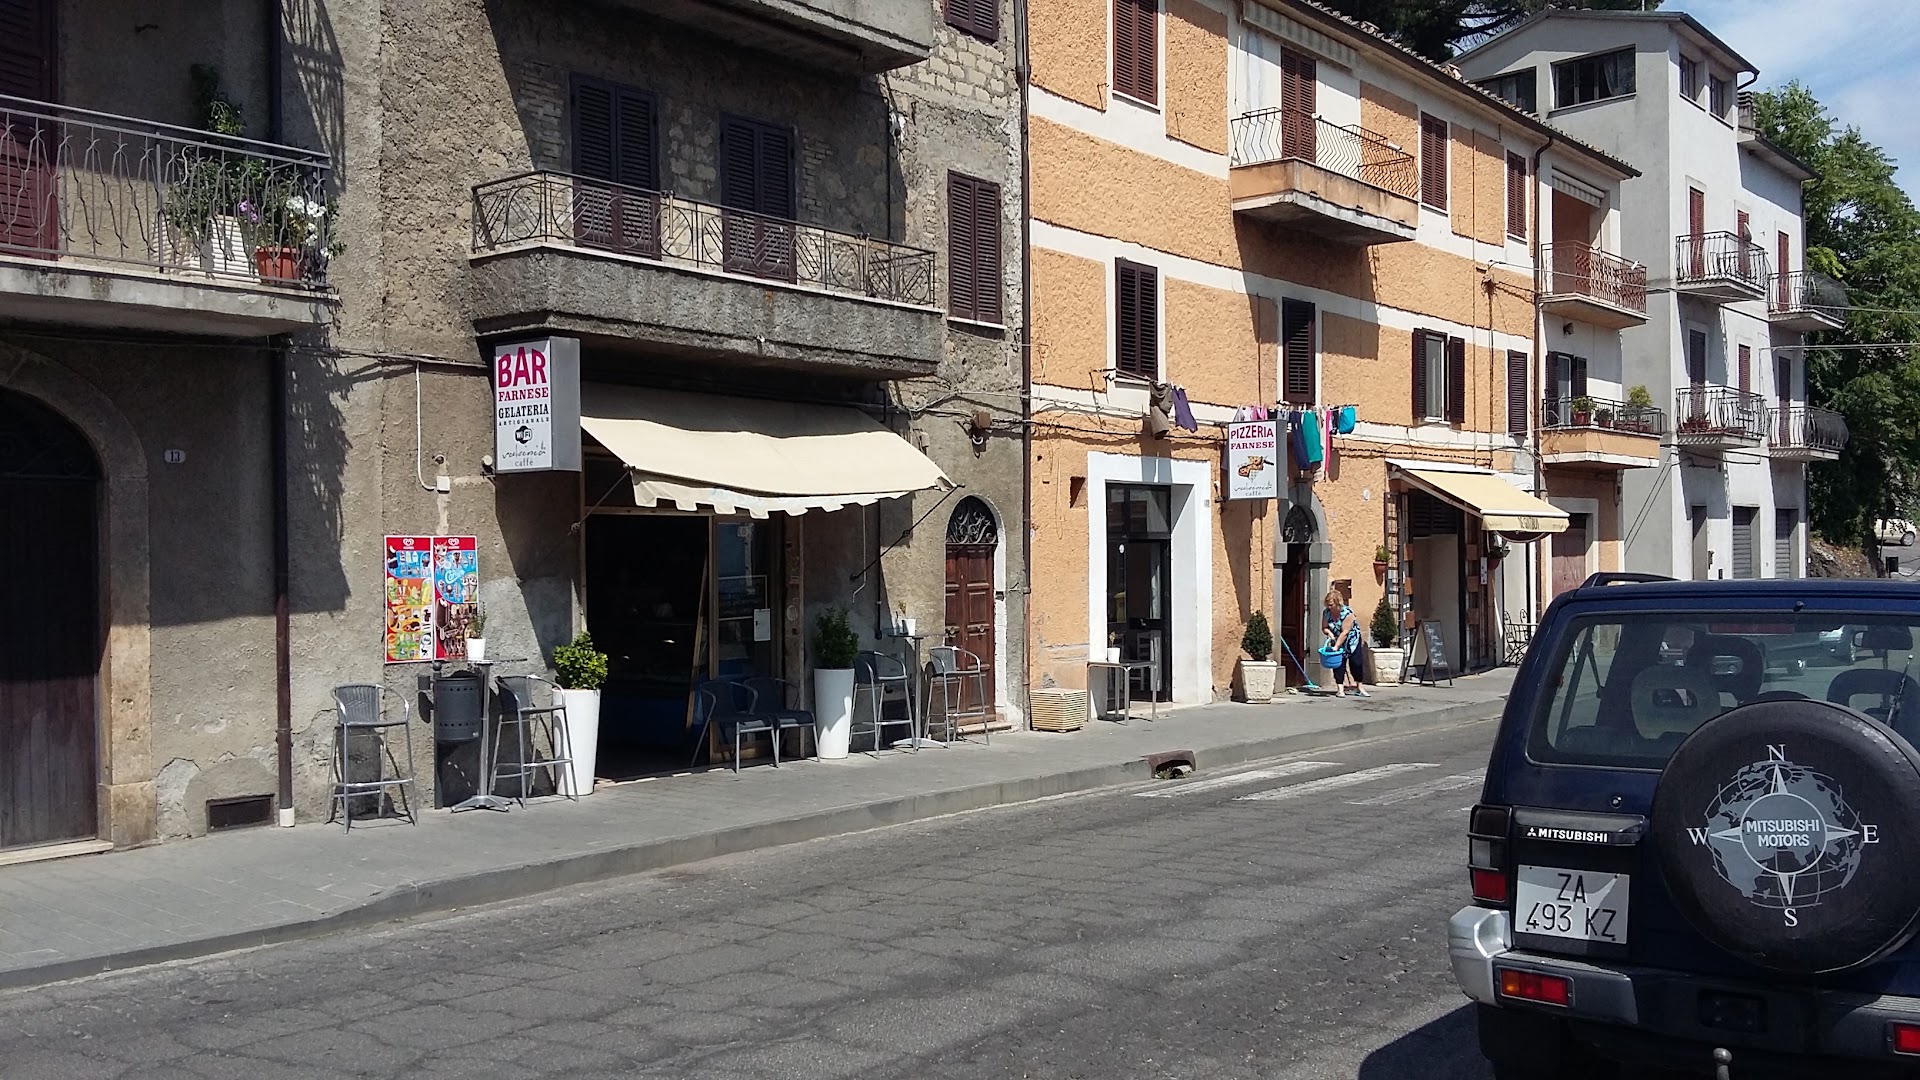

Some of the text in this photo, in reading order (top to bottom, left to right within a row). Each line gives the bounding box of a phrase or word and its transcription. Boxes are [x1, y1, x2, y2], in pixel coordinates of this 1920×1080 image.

[498, 346, 547, 388] BAR
[498, 387, 549, 402] FARNESE
[498, 403, 549, 419] GELATERIA
[498, 417, 550, 426] ARTIGIANALE
[1230, 425, 1274, 439] PIZZERIA
[1230, 441, 1275, 450] FARNESE
[170, 450, 180, 462] 13
[1766, 744, 1785, 763] N
[1746, 819, 1820, 833] MITSUBISHI
[1537, 828, 1608, 843] MITSUBISHI
[1686, 827, 1710, 846] W
[1758, 834, 1810, 847] MOTORS
[1862, 824, 1880, 844] E
[1556, 872, 1587, 904] ZA
[1526, 902, 1617, 938] 493 KZ
[1784, 907, 1798, 927] S
